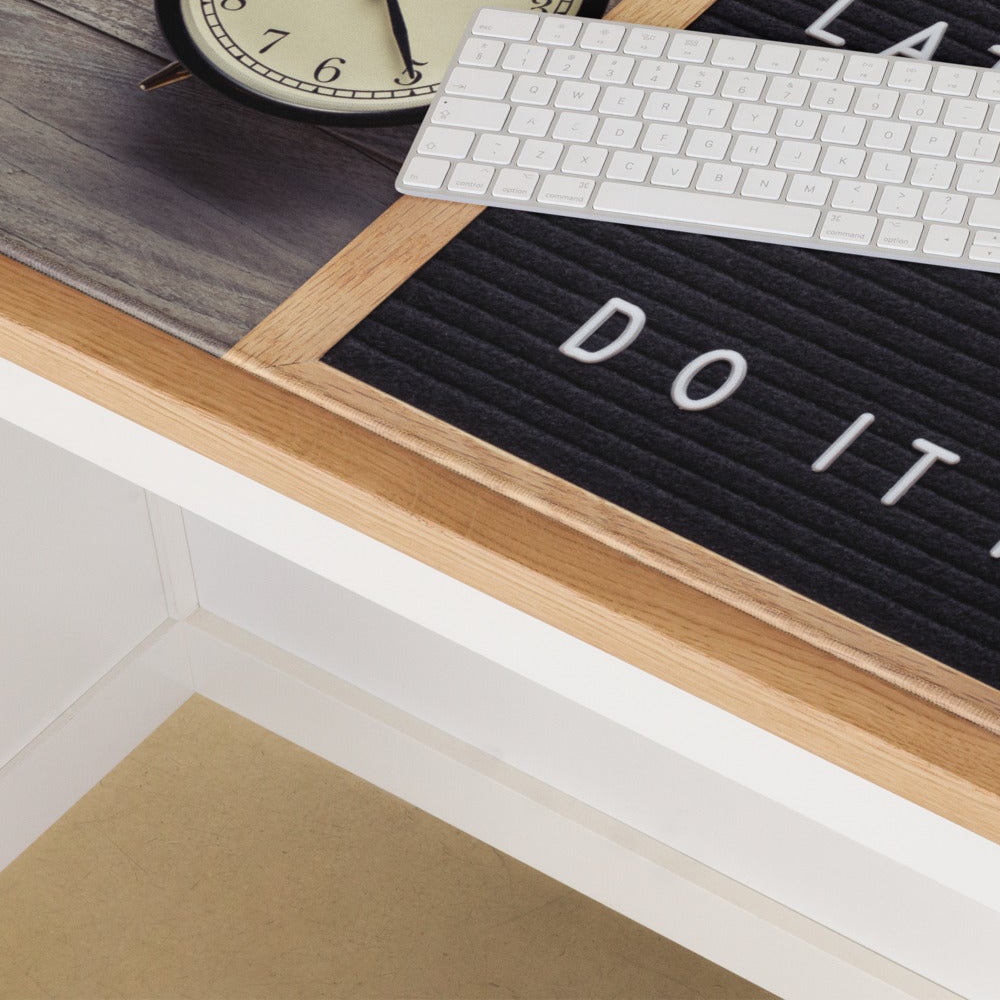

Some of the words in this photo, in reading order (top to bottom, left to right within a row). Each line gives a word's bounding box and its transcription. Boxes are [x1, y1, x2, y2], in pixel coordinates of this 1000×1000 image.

[258, 28, 291, 55] 7
[313, 56, 347, 84] 6
[559, 296, 748, 411] DO
[811, 412, 961, 506] IT
